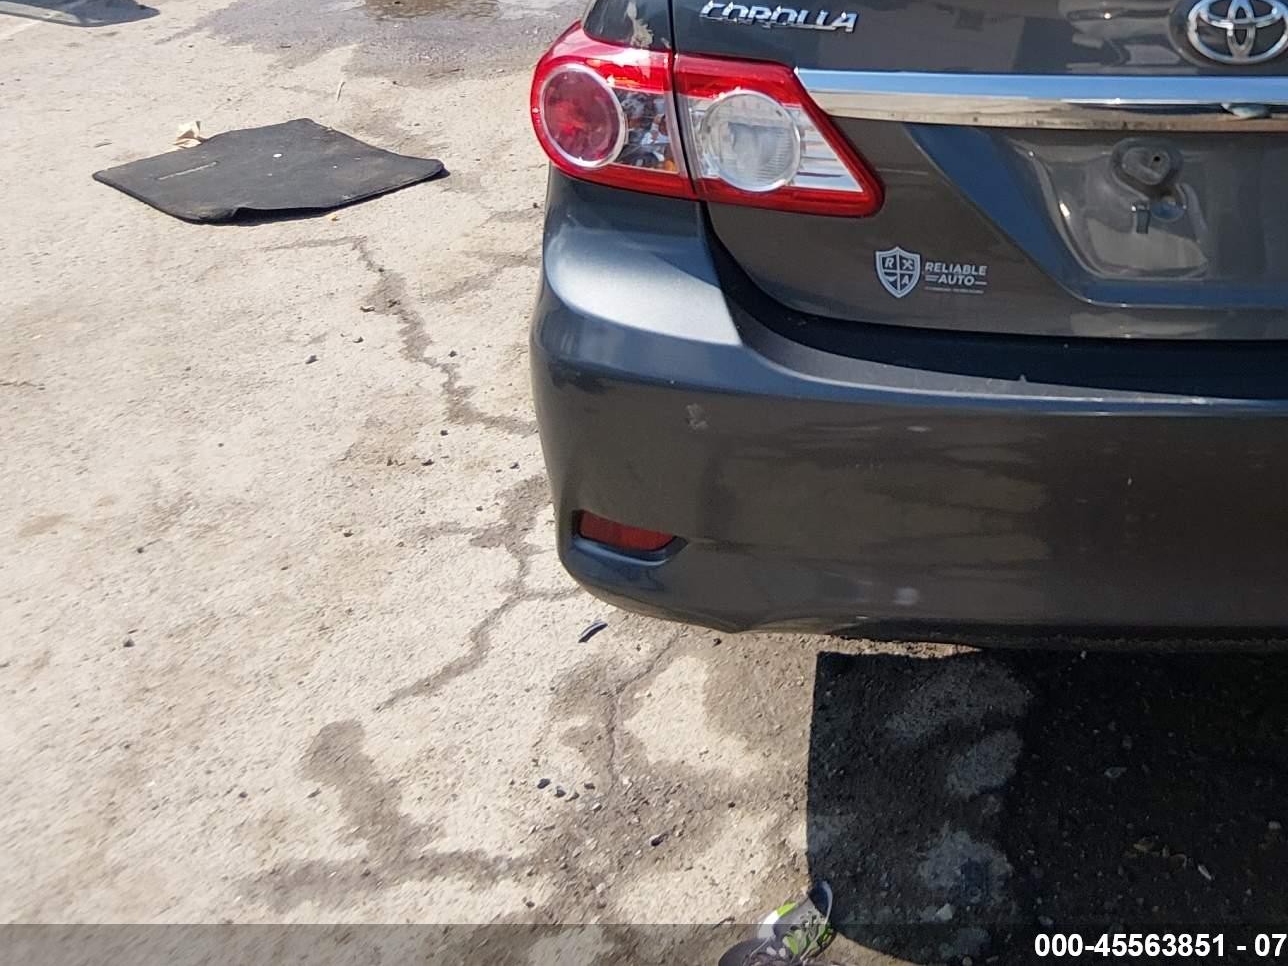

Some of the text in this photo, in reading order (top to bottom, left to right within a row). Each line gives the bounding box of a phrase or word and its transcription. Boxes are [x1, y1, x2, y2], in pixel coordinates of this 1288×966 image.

[700, 0, 858, 33] COROLLA
[884, 257, 893, 268] R
[925, 262, 987, 276] RELIABLE
[938, 275, 975, 286] AUTO
